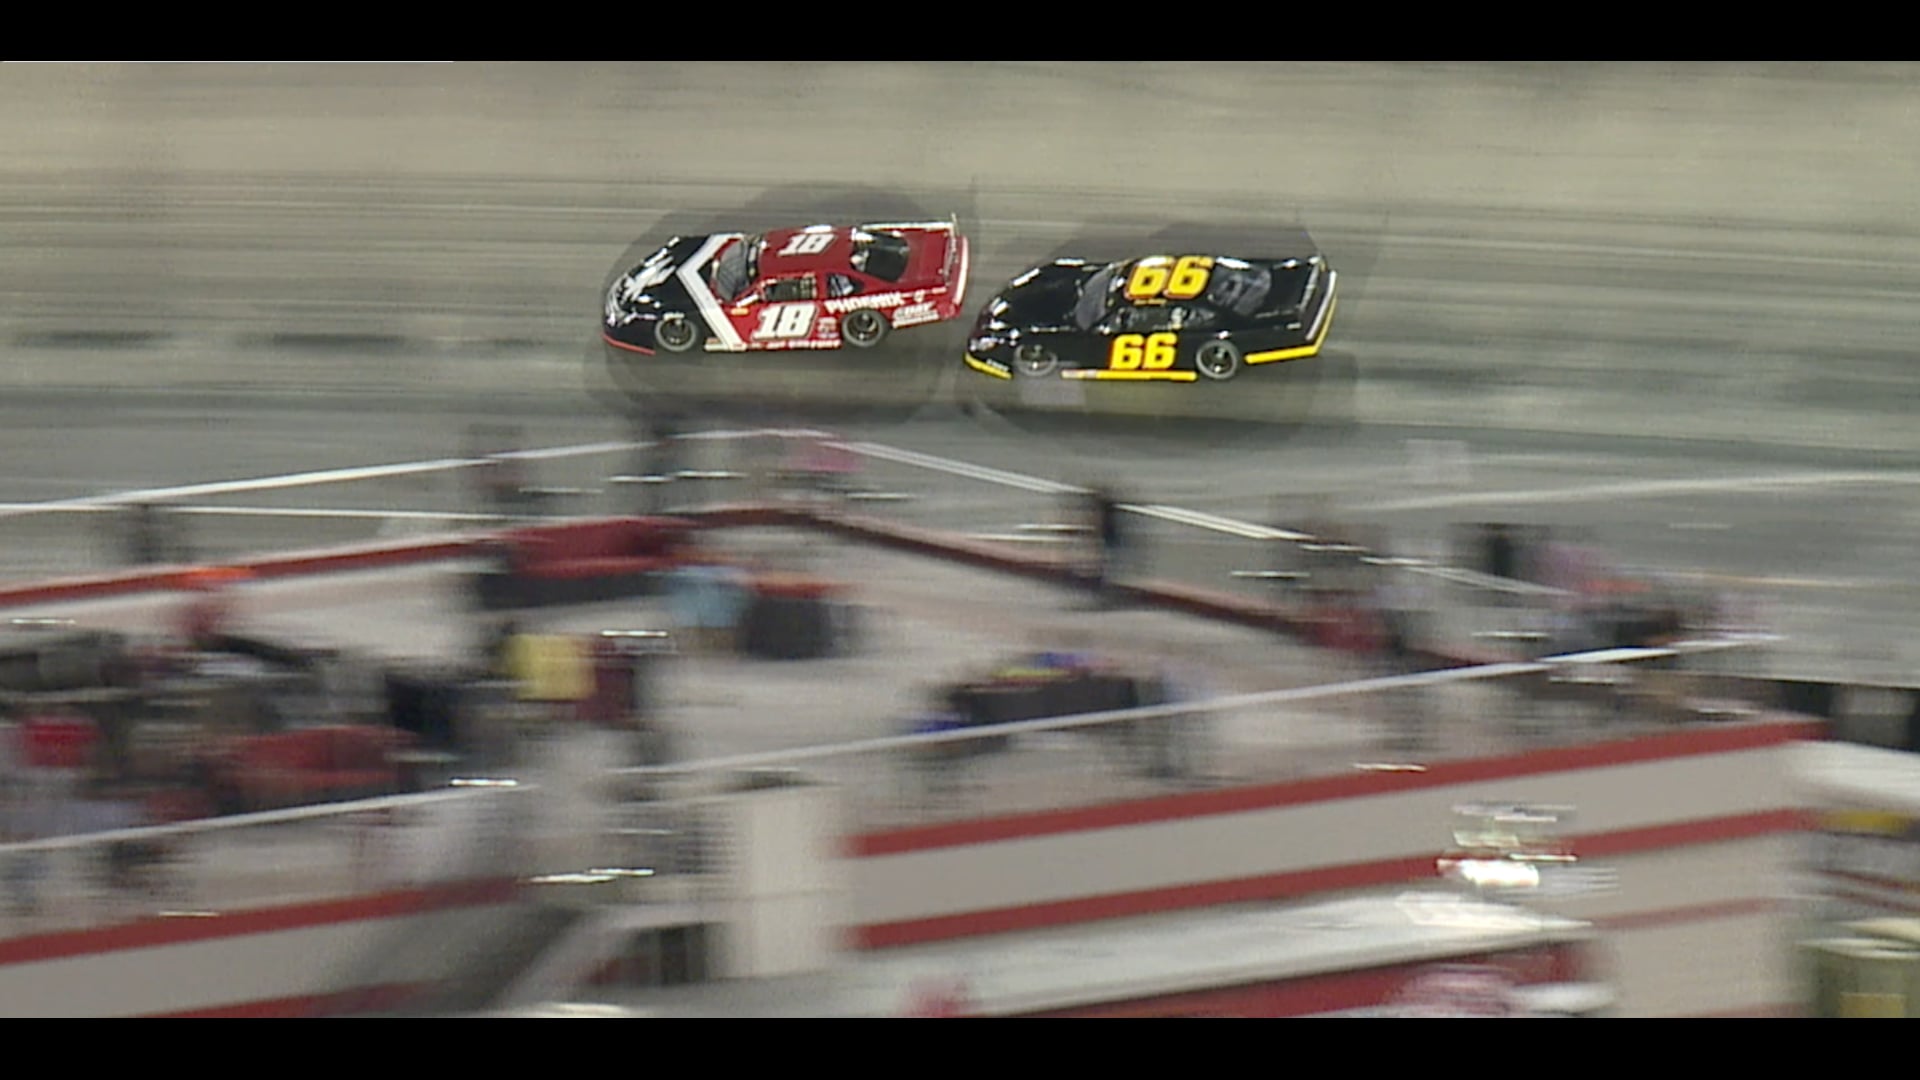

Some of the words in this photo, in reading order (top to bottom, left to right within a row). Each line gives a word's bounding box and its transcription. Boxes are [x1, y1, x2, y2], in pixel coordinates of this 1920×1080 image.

[777, 232, 835, 257] 18
[1125, 255, 1213, 299] 66
[752, 303, 817, 341] 18
[823, 291, 906, 315] PHOENIX
[1108, 332, 1178, 371] 66
